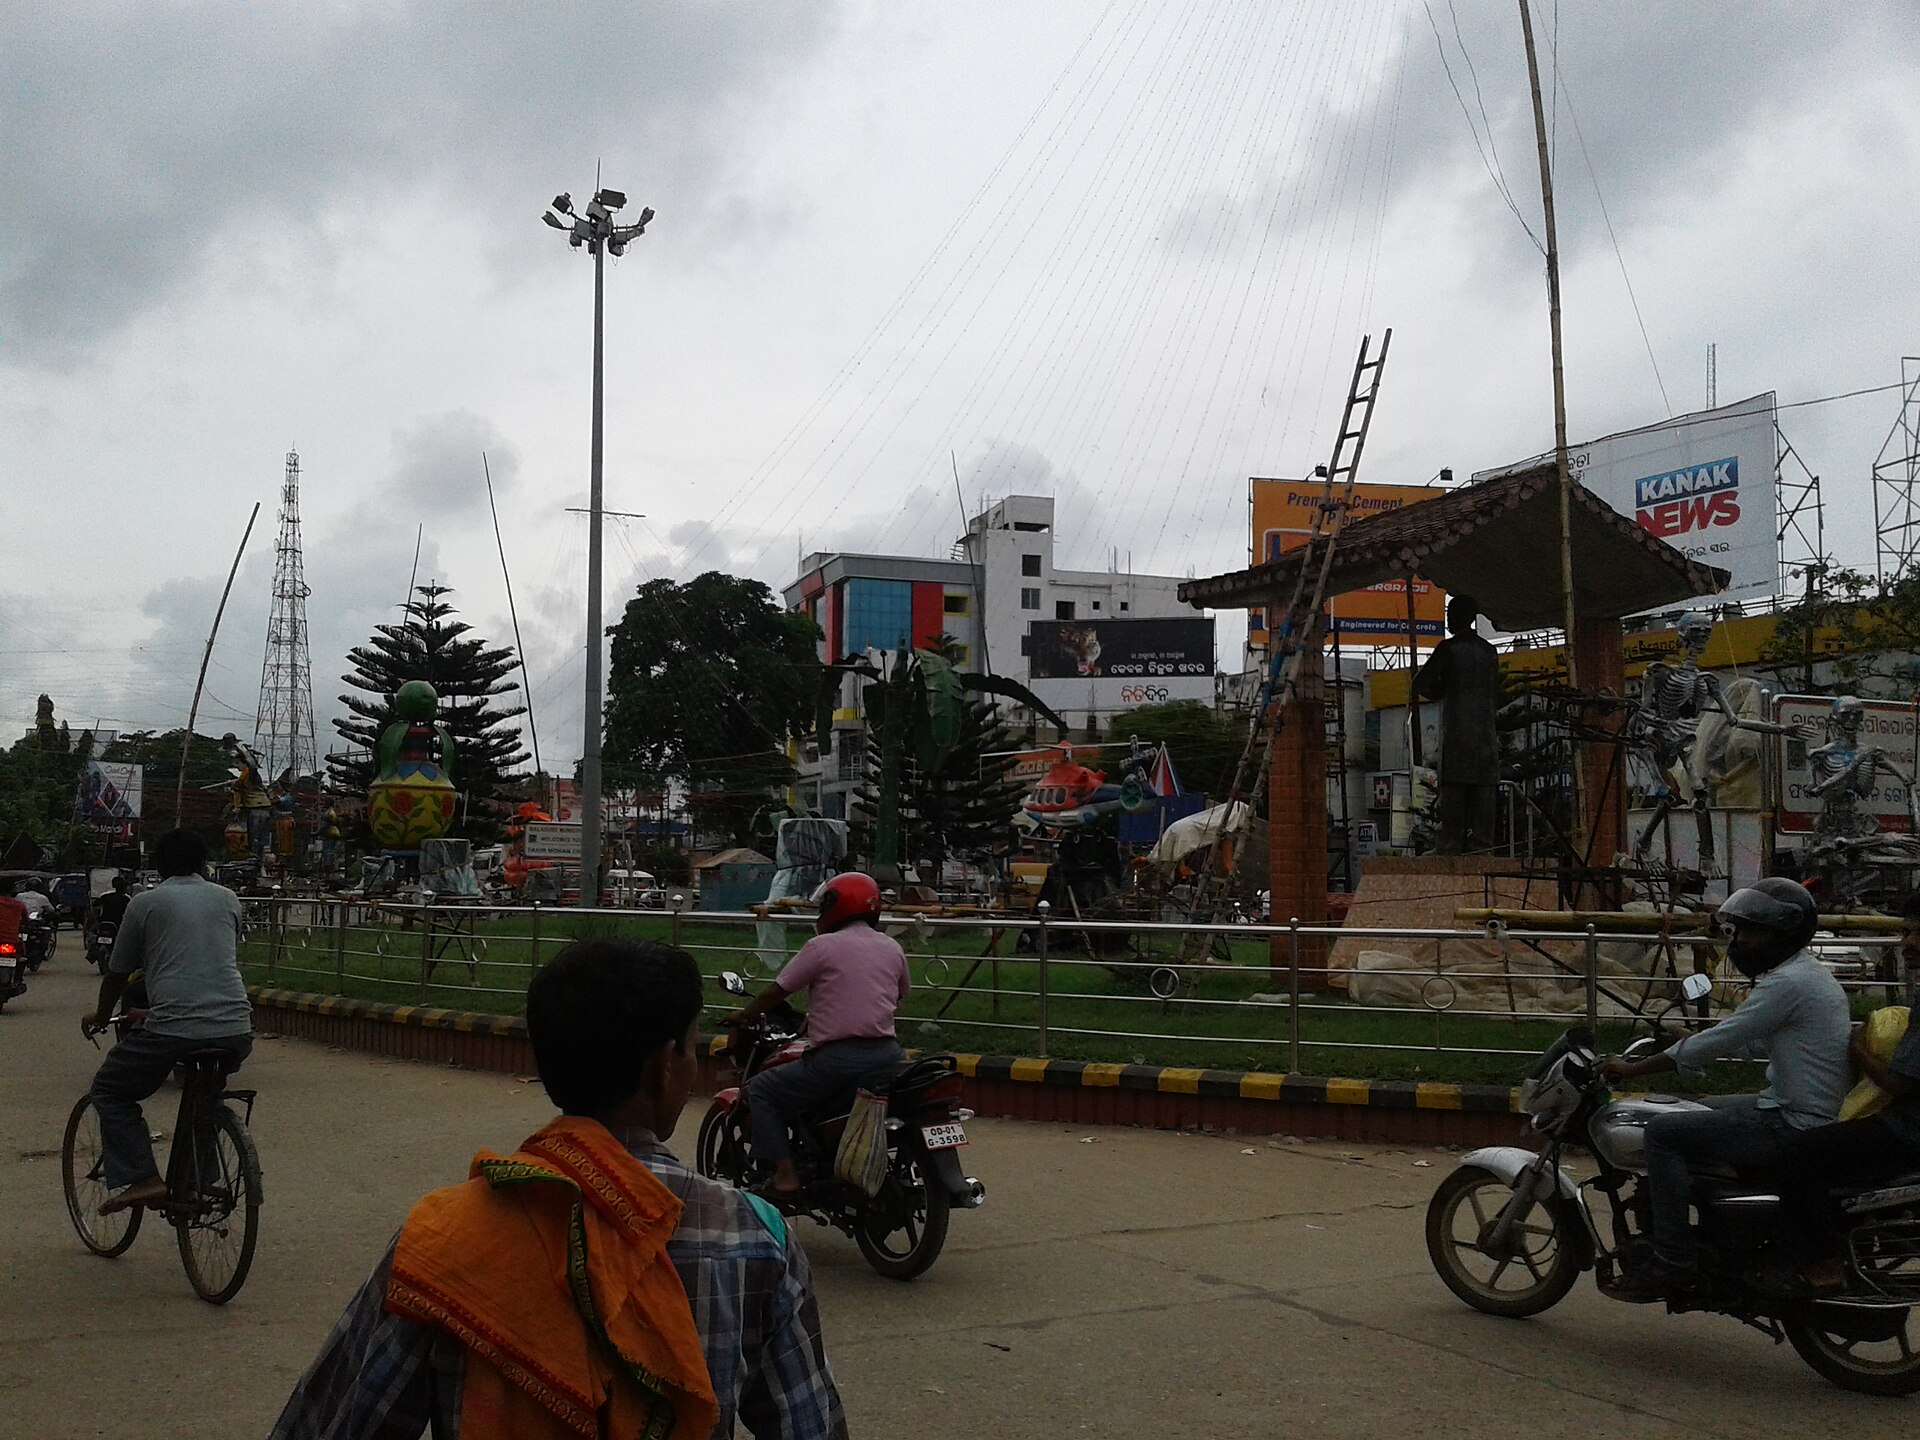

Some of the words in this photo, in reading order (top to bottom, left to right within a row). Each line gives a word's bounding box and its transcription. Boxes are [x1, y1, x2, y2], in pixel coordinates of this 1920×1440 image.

[1640, 463, 1732, 502] KANAK
[1353, 495, 1404, 511] Cement
[1635, 490, 1741, 538] NEWS
[1340, 620, 1386, 630] Engineered
[1387, 621, 1399, 629] for
[930, 1125, 956, 1136] OD-01
[927, 1134, 966, 1147] G-3598
